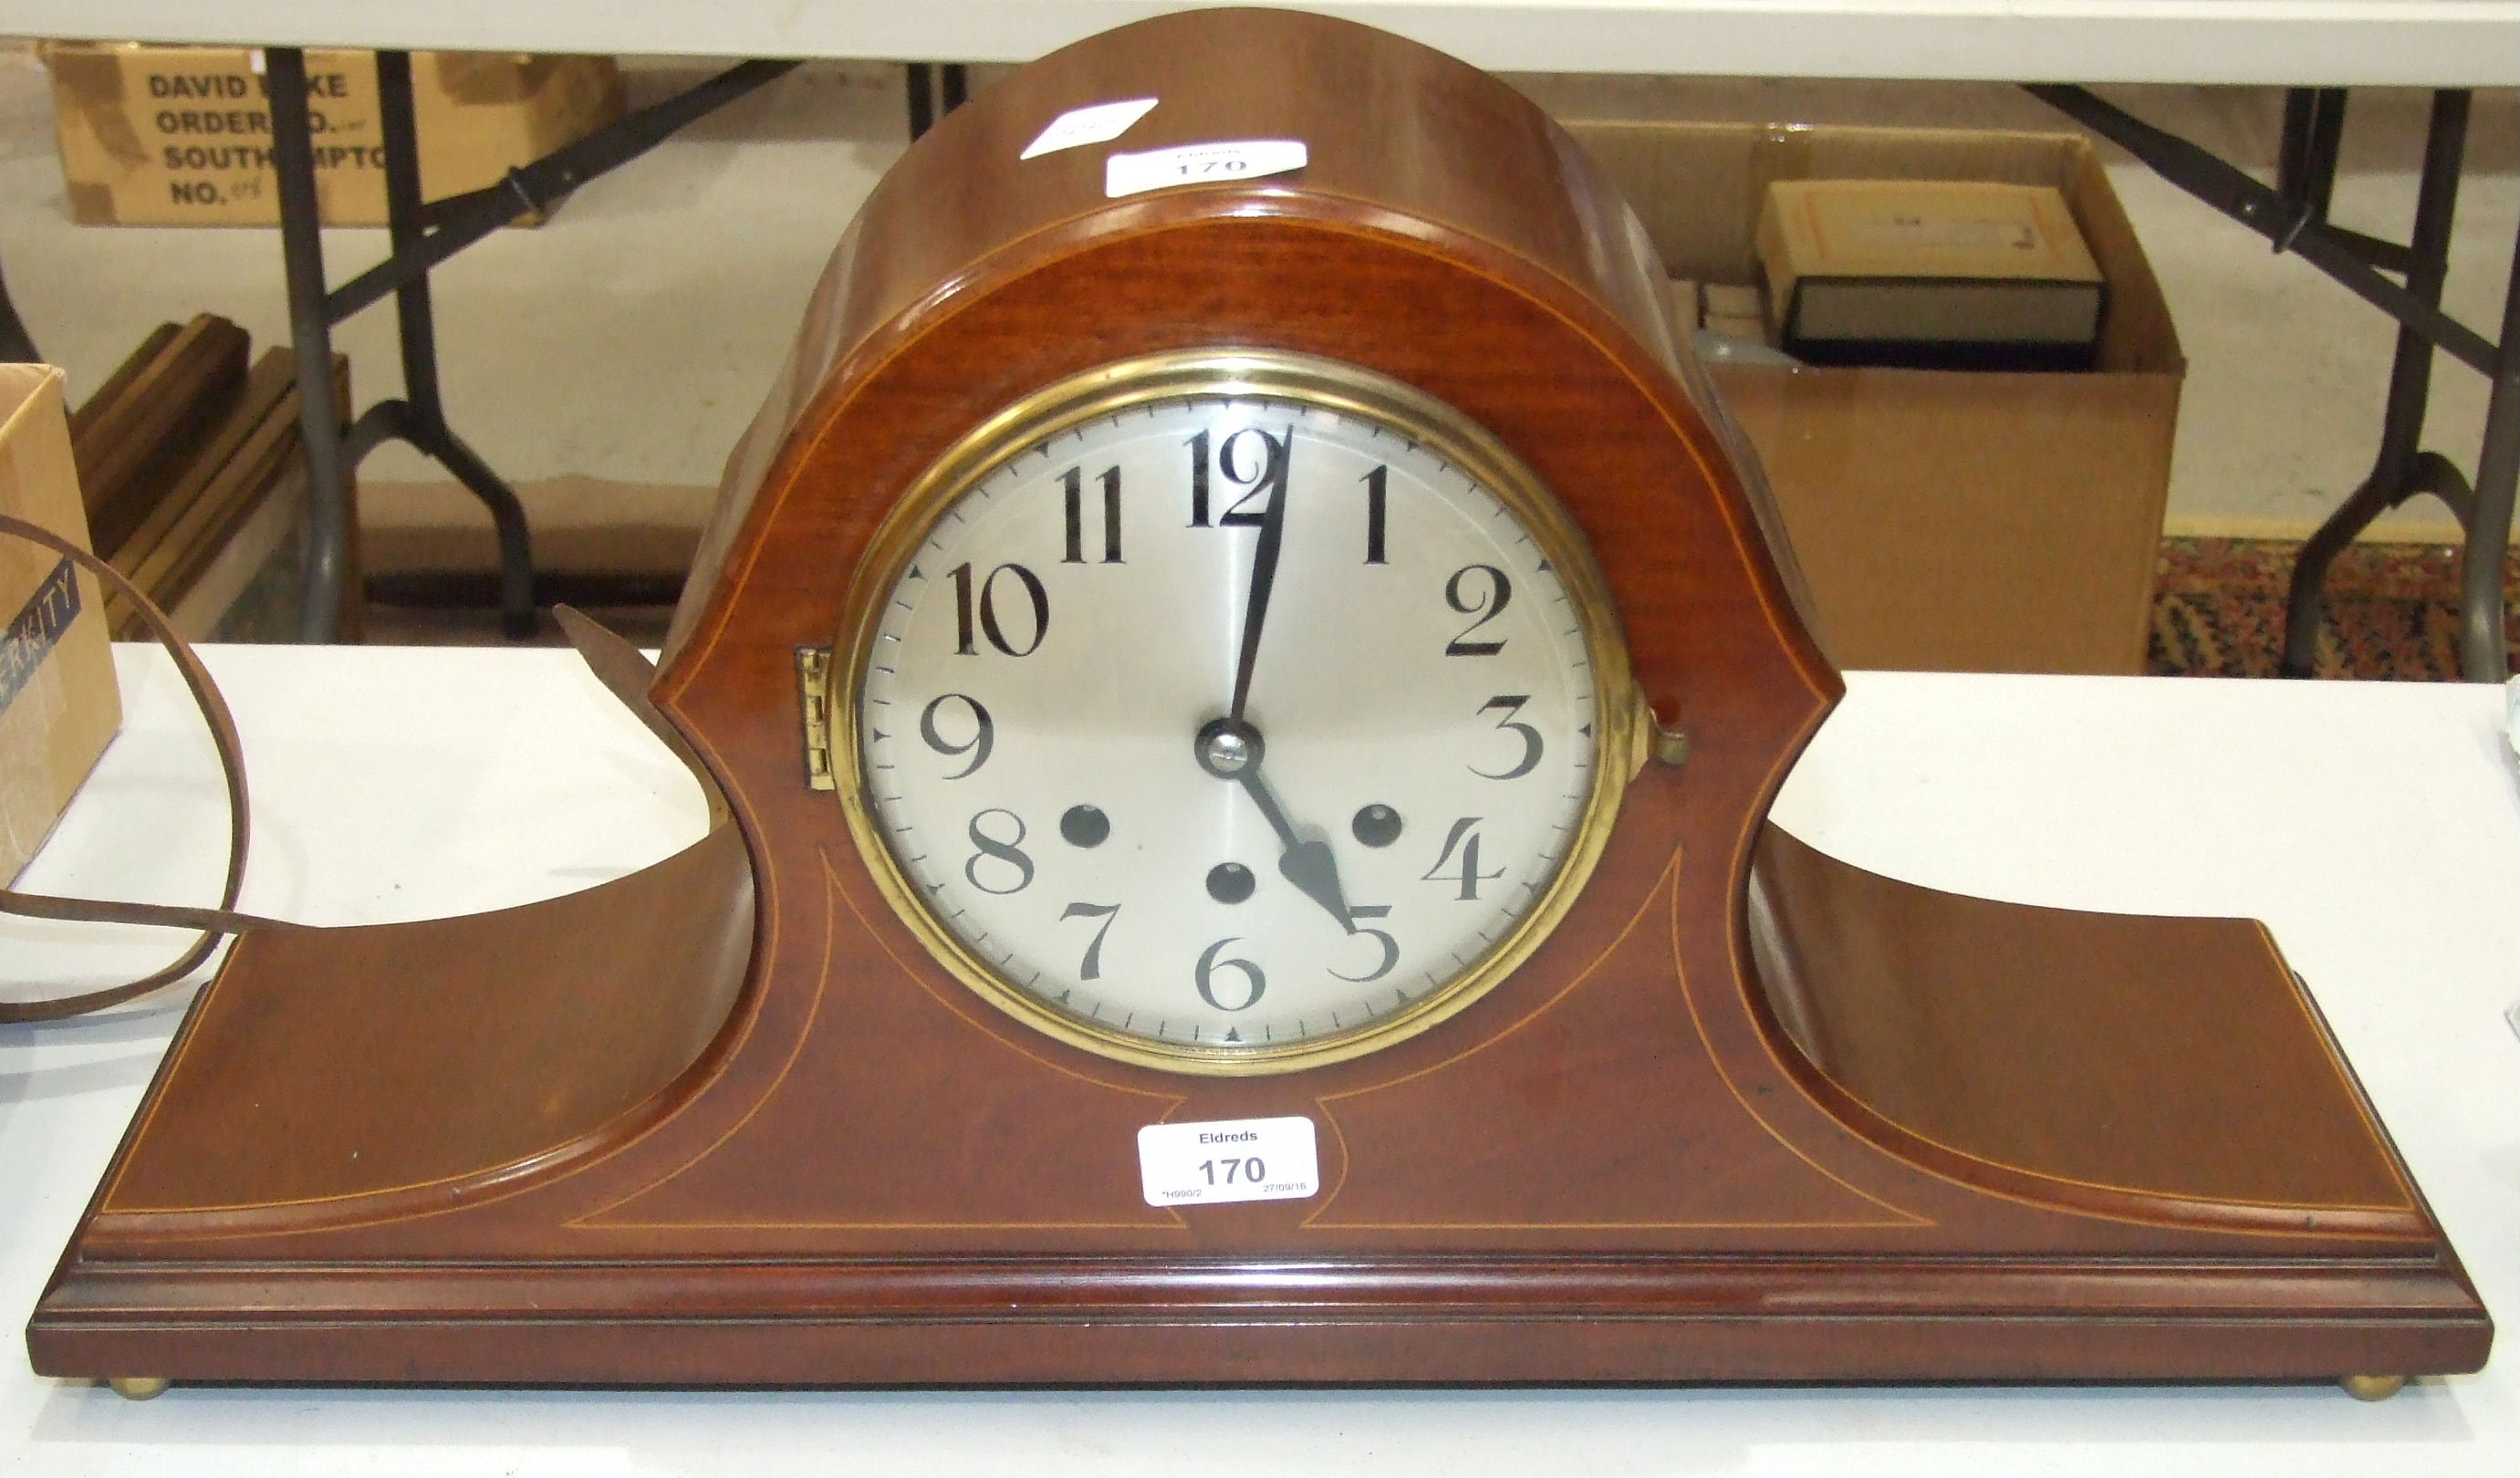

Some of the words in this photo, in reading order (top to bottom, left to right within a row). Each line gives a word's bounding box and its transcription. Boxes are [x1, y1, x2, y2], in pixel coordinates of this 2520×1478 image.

[150, 75, 248, 99] DAVID
[156, 110, 271, 135] ORDER
[171, 181, 227, 206] NO.
[1176, 160, 1247, 176] 170
[1054, 465, 1127, 565] 11
[1182, 428, 1283, 529] 12
[1358, 463, 1391, 566] 1
[945, 562, 1050, 658] 10
[1444, 564, 1513, 658] 2
[920, 692, 995, 781] 9
[1465, 694, 1545, 781] 3
[963, 807, 1036, 896] 8
[1420, 816, 1505, 902] 4
[1059, 901, 1121, 982] 7
[1193, 936, 1267, 1013] 6
[1325, 904, 1401, 984] 5
[1198, 1156, 1266, 1186] 170
[1199, 1130, 1258, 1144] Eldreds
